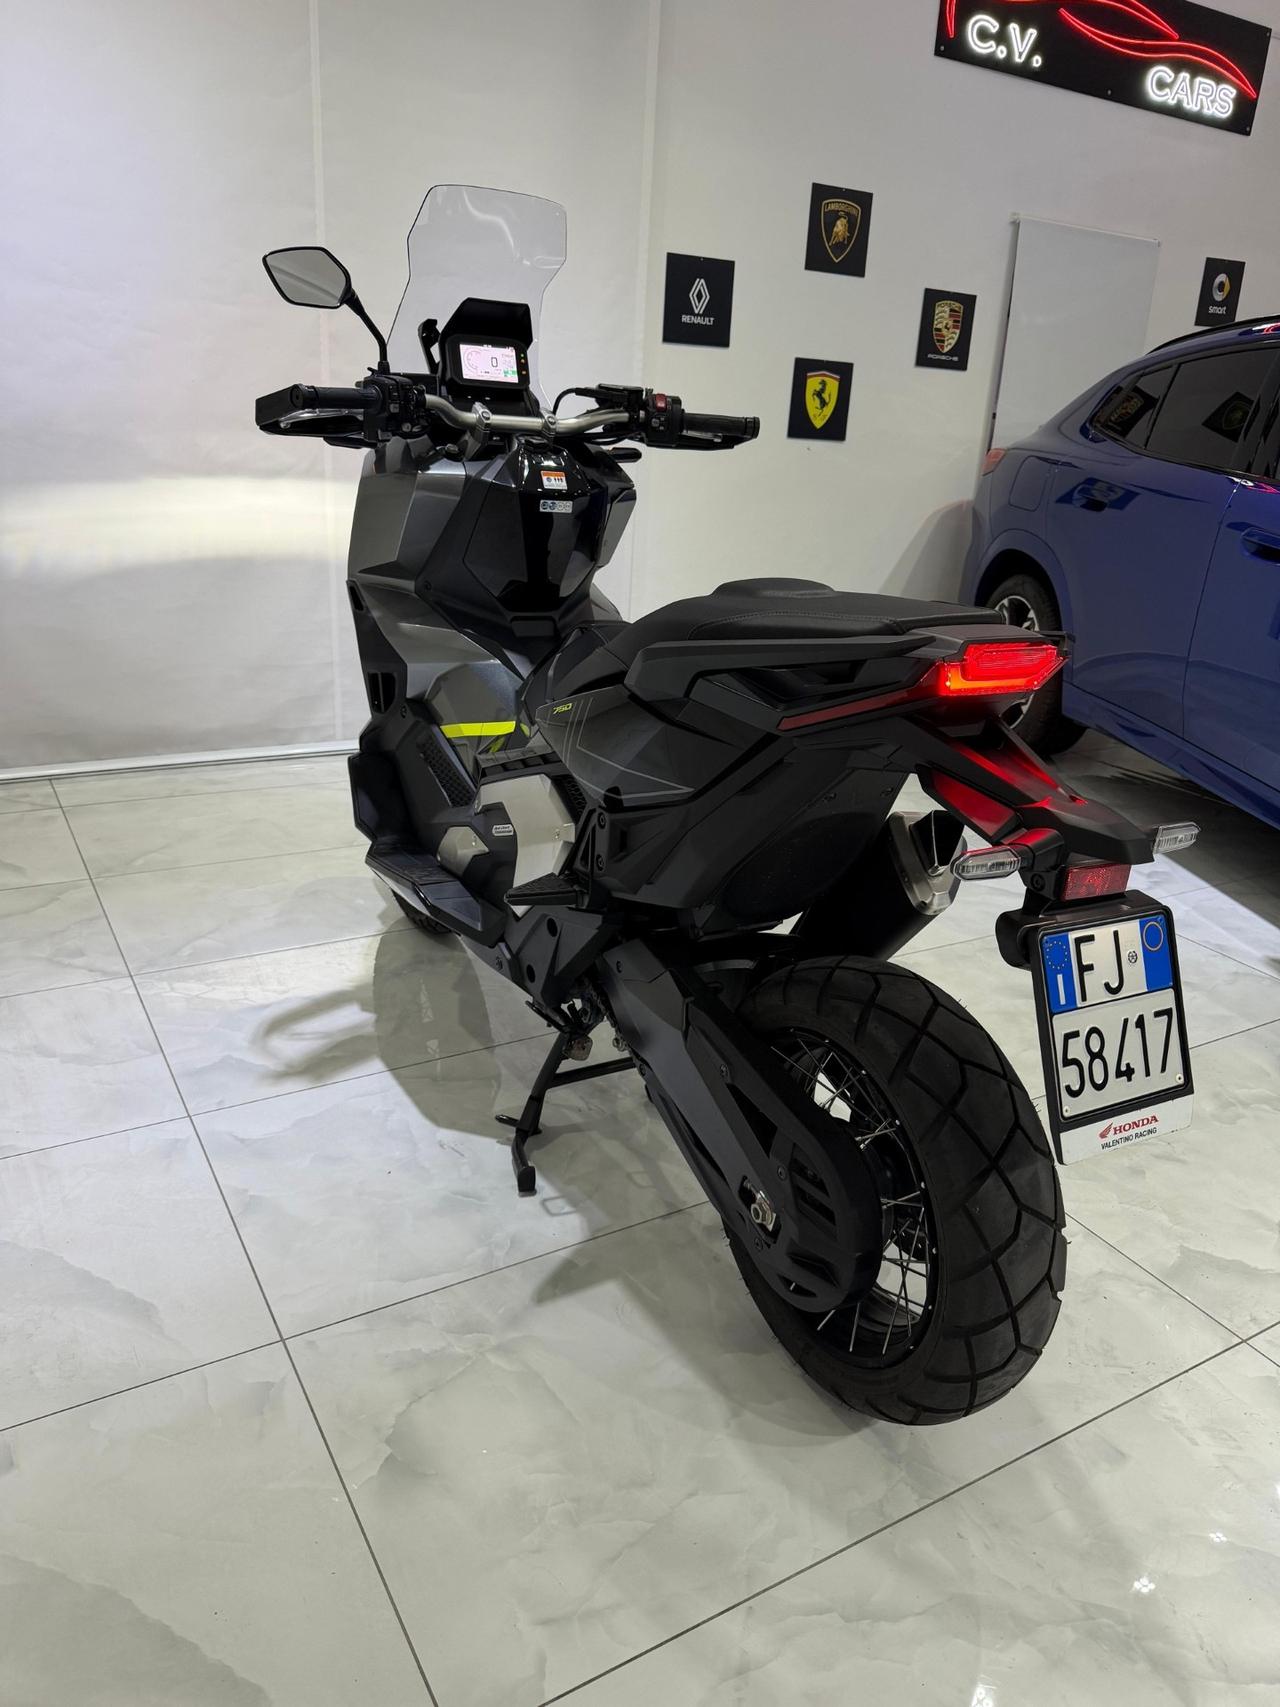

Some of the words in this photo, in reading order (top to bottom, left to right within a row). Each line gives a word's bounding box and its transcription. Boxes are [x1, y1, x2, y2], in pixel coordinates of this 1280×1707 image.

[967, 15, 1041, 67] C.V.
[1147, 65, 1237, 118] CARS
[681, 314, 714, 325] RENAULT
[1208, 305, 1226, 314] smart
[553, 703, 572, 714] 750
[1073, 929, 1124, 1002] FJ
[1061, 1006, 1173, 1098] 58417
[1112, 1115, 1159, 1135] HONDA
[1101, 1133, 1134, 1150] VALENTINO
[1134, 1126, 1158, 1140] RACING
